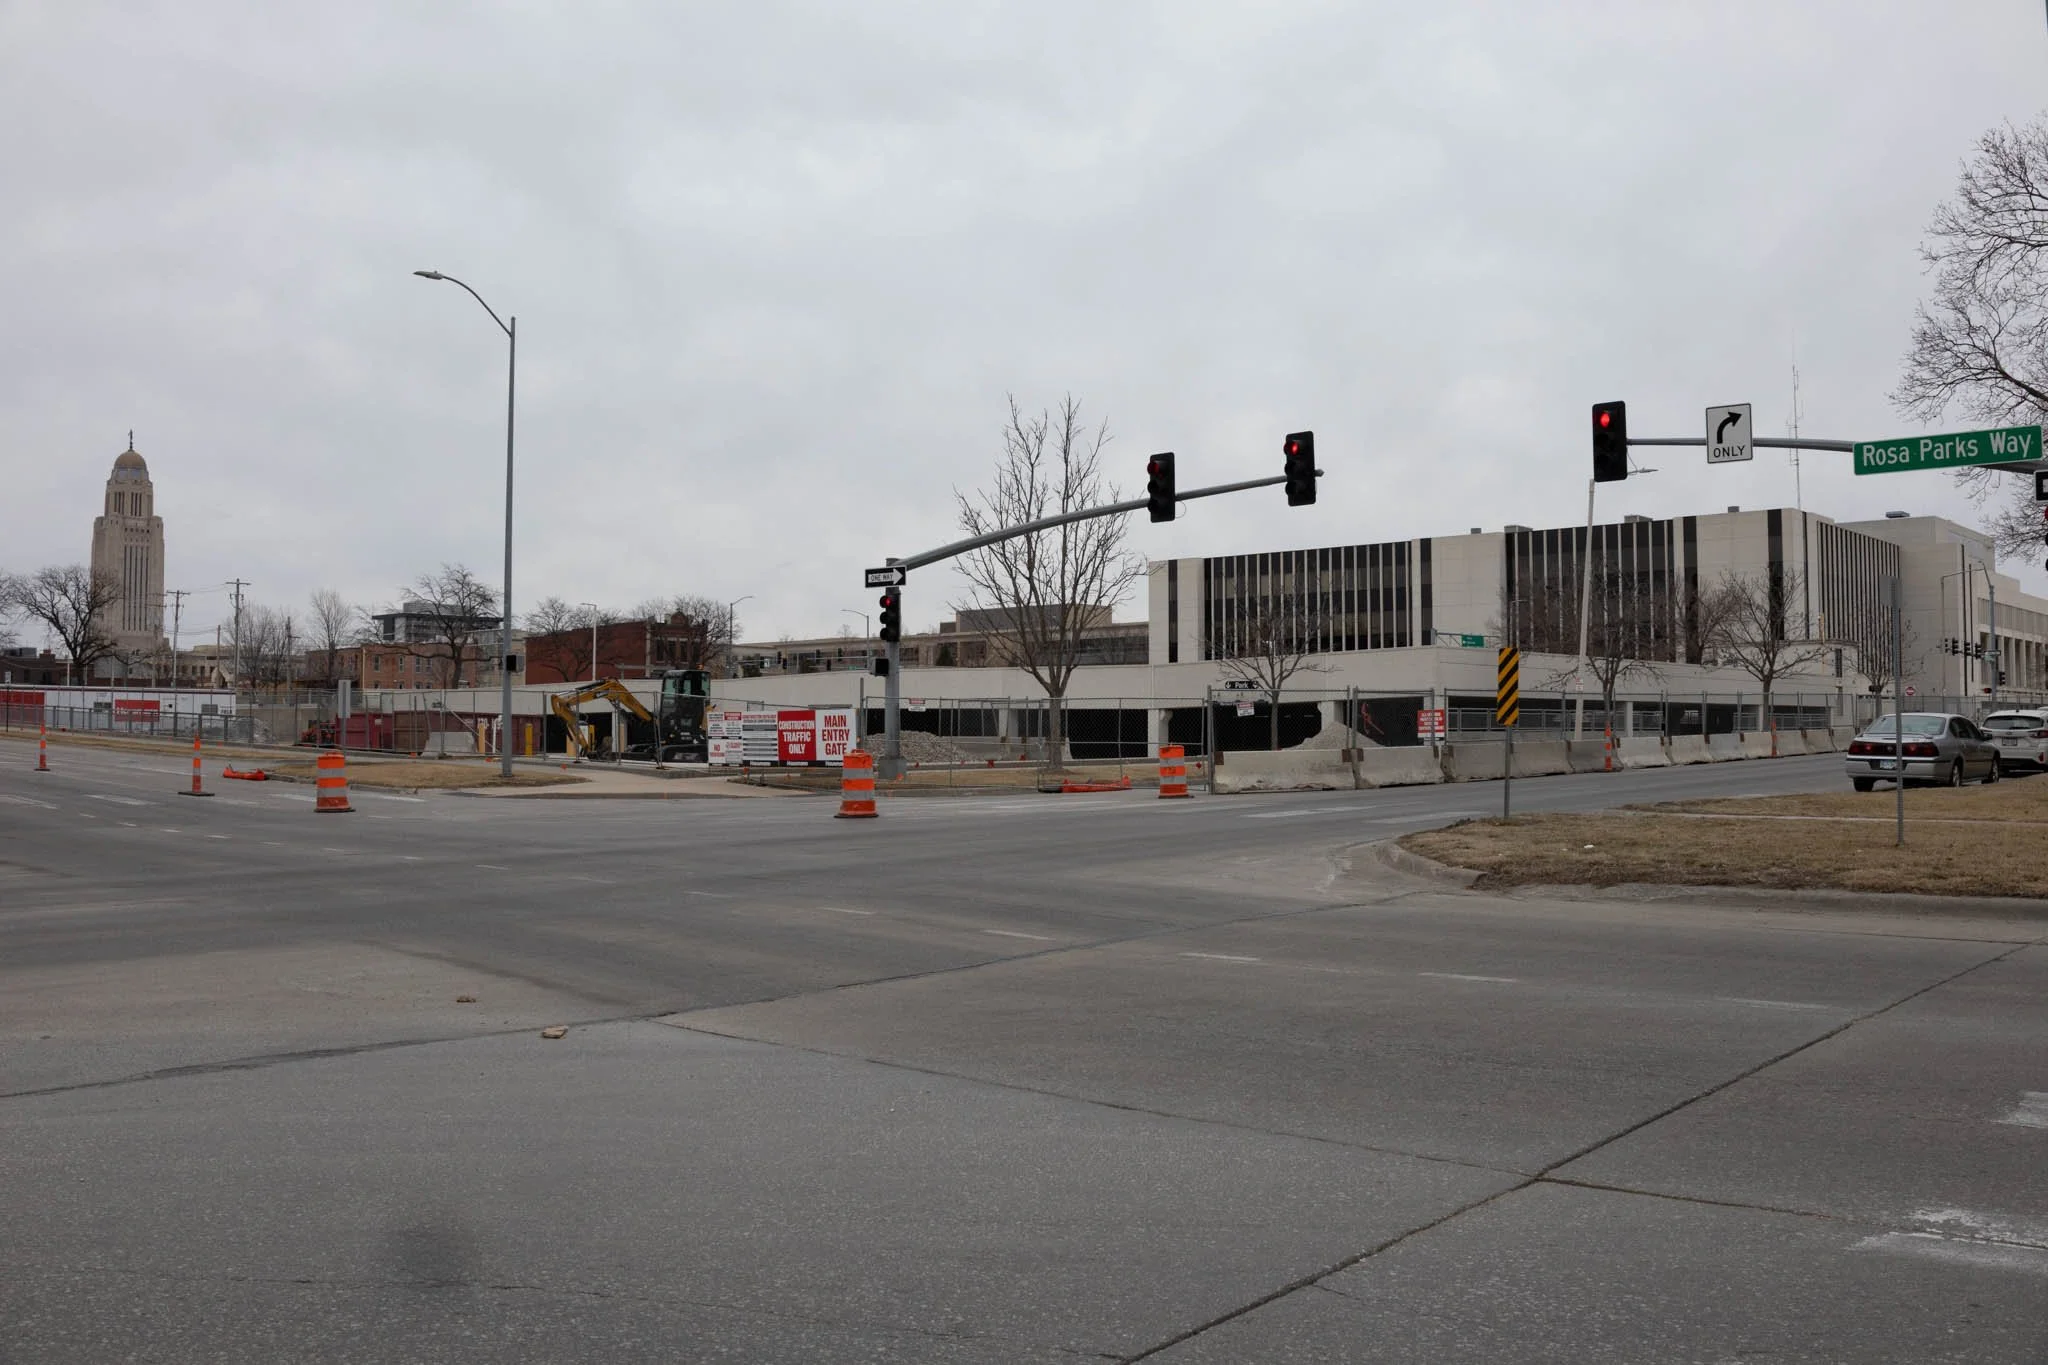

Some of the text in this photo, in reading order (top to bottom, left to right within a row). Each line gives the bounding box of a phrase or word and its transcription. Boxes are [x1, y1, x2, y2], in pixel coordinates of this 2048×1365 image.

[1713, 444, 1745, 458] ONLY
[1863, 431, 2032, 466] Rosa Parks Way
[870, 573, 893, 582] ONE WAY
[1234, 681, 1248, 689] Park
[778, 720, 815, 730] CONSTRUCTION
[824, 715, 847, 728] MAIN
[783, 731, 811, 743] TRAFFIC
[822, 729, 850, 742] ENTRY
[789, 743, 806, 755] ONLY
[825, 742, 848, 755] GATE
